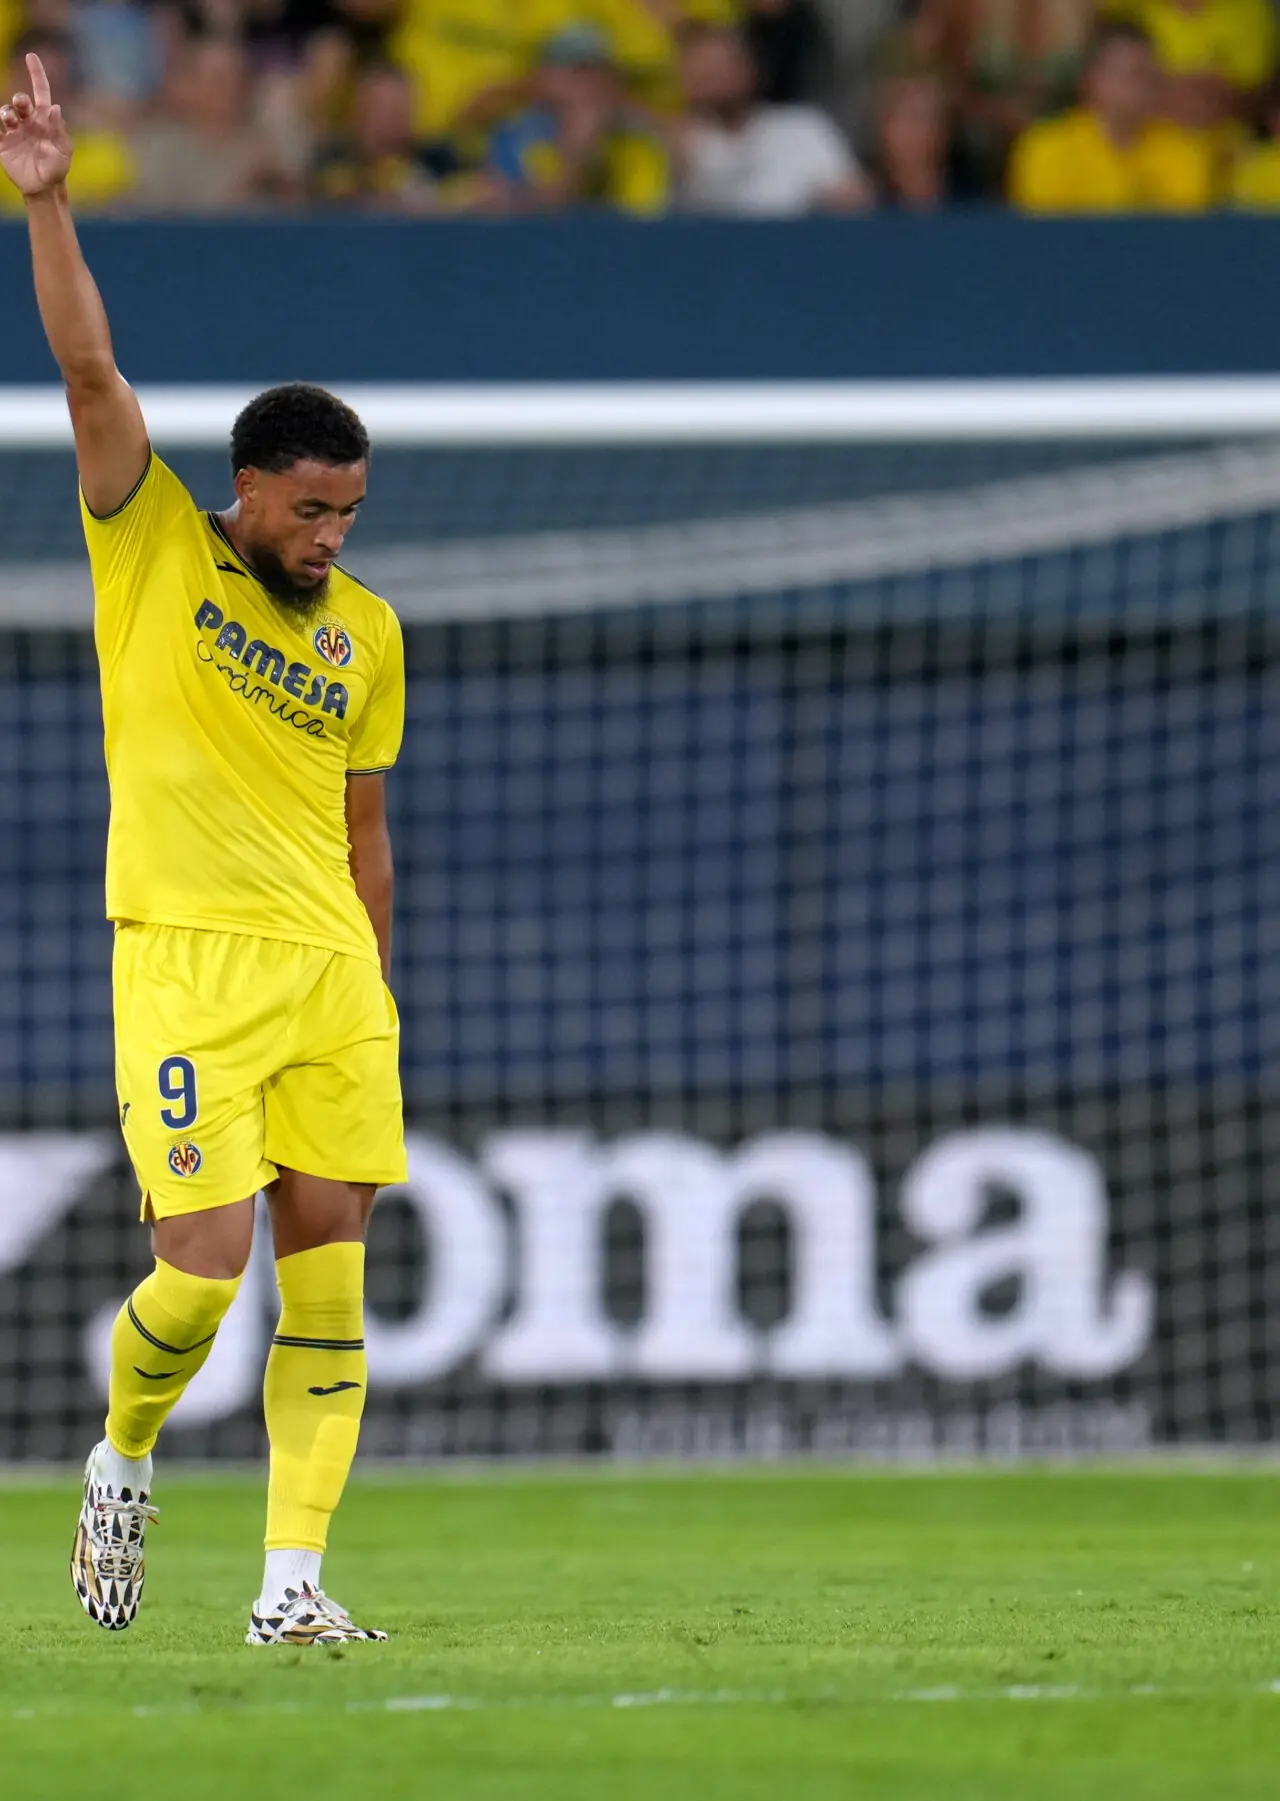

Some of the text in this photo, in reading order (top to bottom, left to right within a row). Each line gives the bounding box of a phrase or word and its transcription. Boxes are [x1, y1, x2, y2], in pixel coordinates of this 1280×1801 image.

[195, 599, 348, 720] PAMESA
[196, 640, 326, 737] Crámica
[158, 1054, 198, 1129] 9
